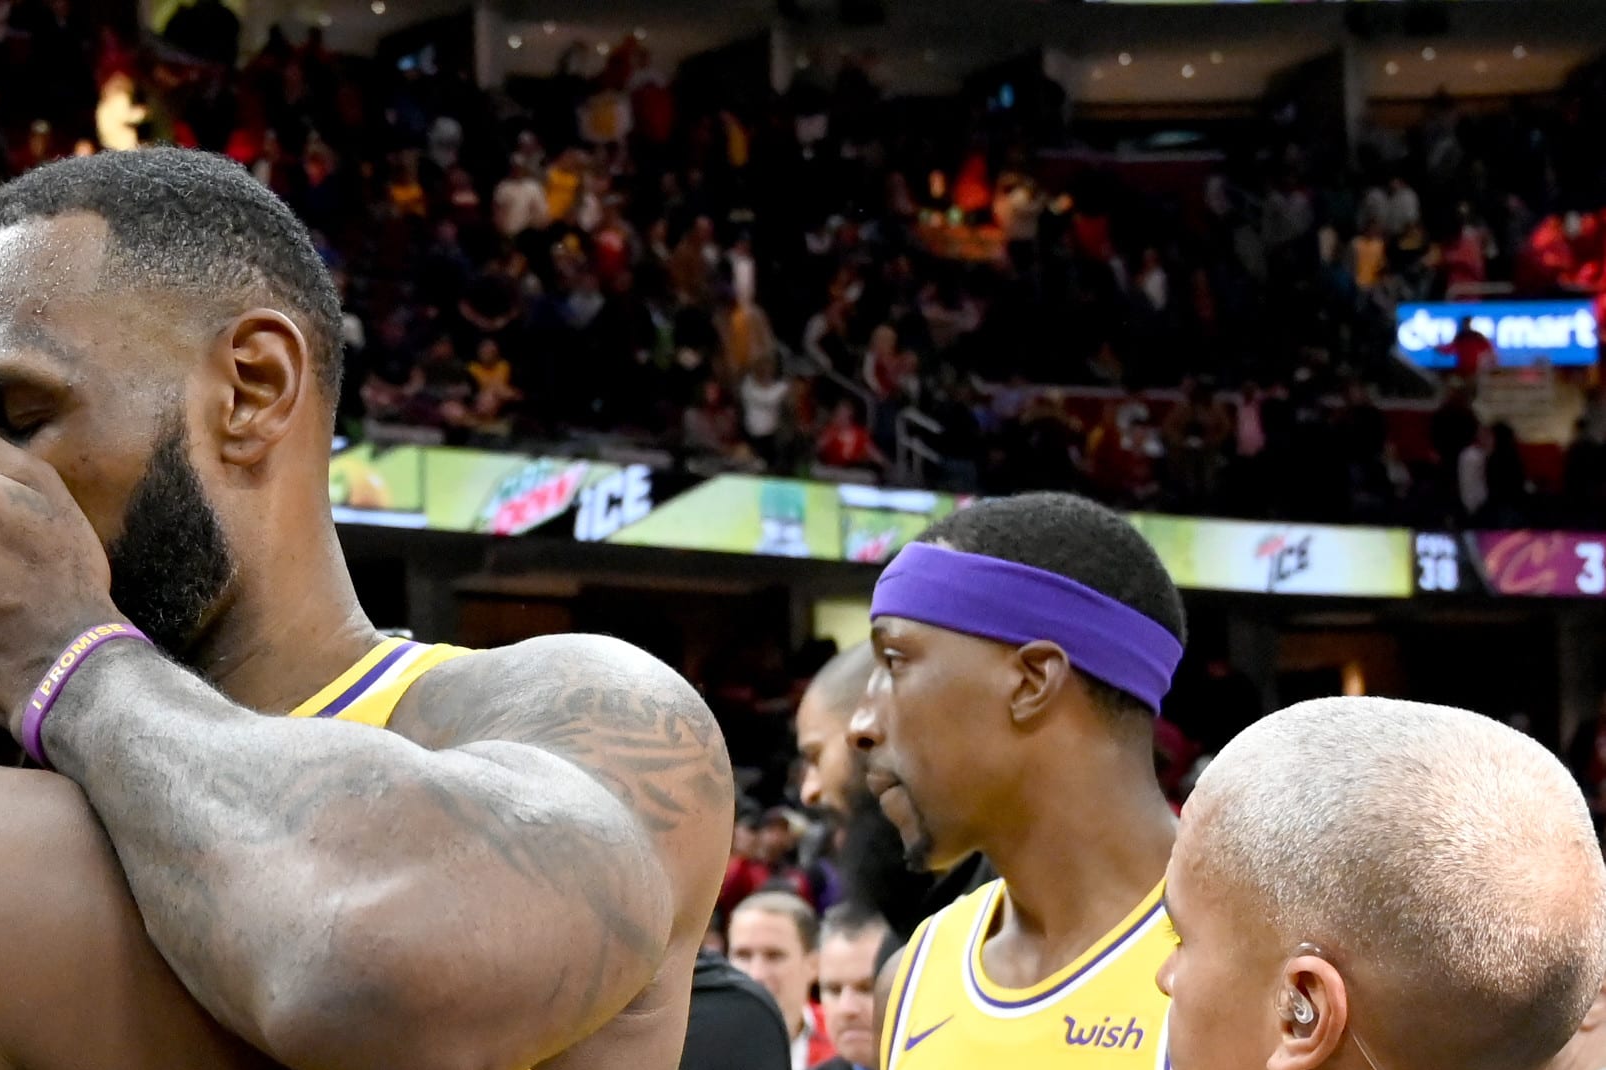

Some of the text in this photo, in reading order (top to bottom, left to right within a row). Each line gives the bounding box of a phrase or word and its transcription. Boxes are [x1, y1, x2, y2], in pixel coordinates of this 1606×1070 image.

[1496, 308, 1598, 349] mart
[31, 623, 128, 710] I PROMISE
[1063, 1014, 1144, 1050] wish
